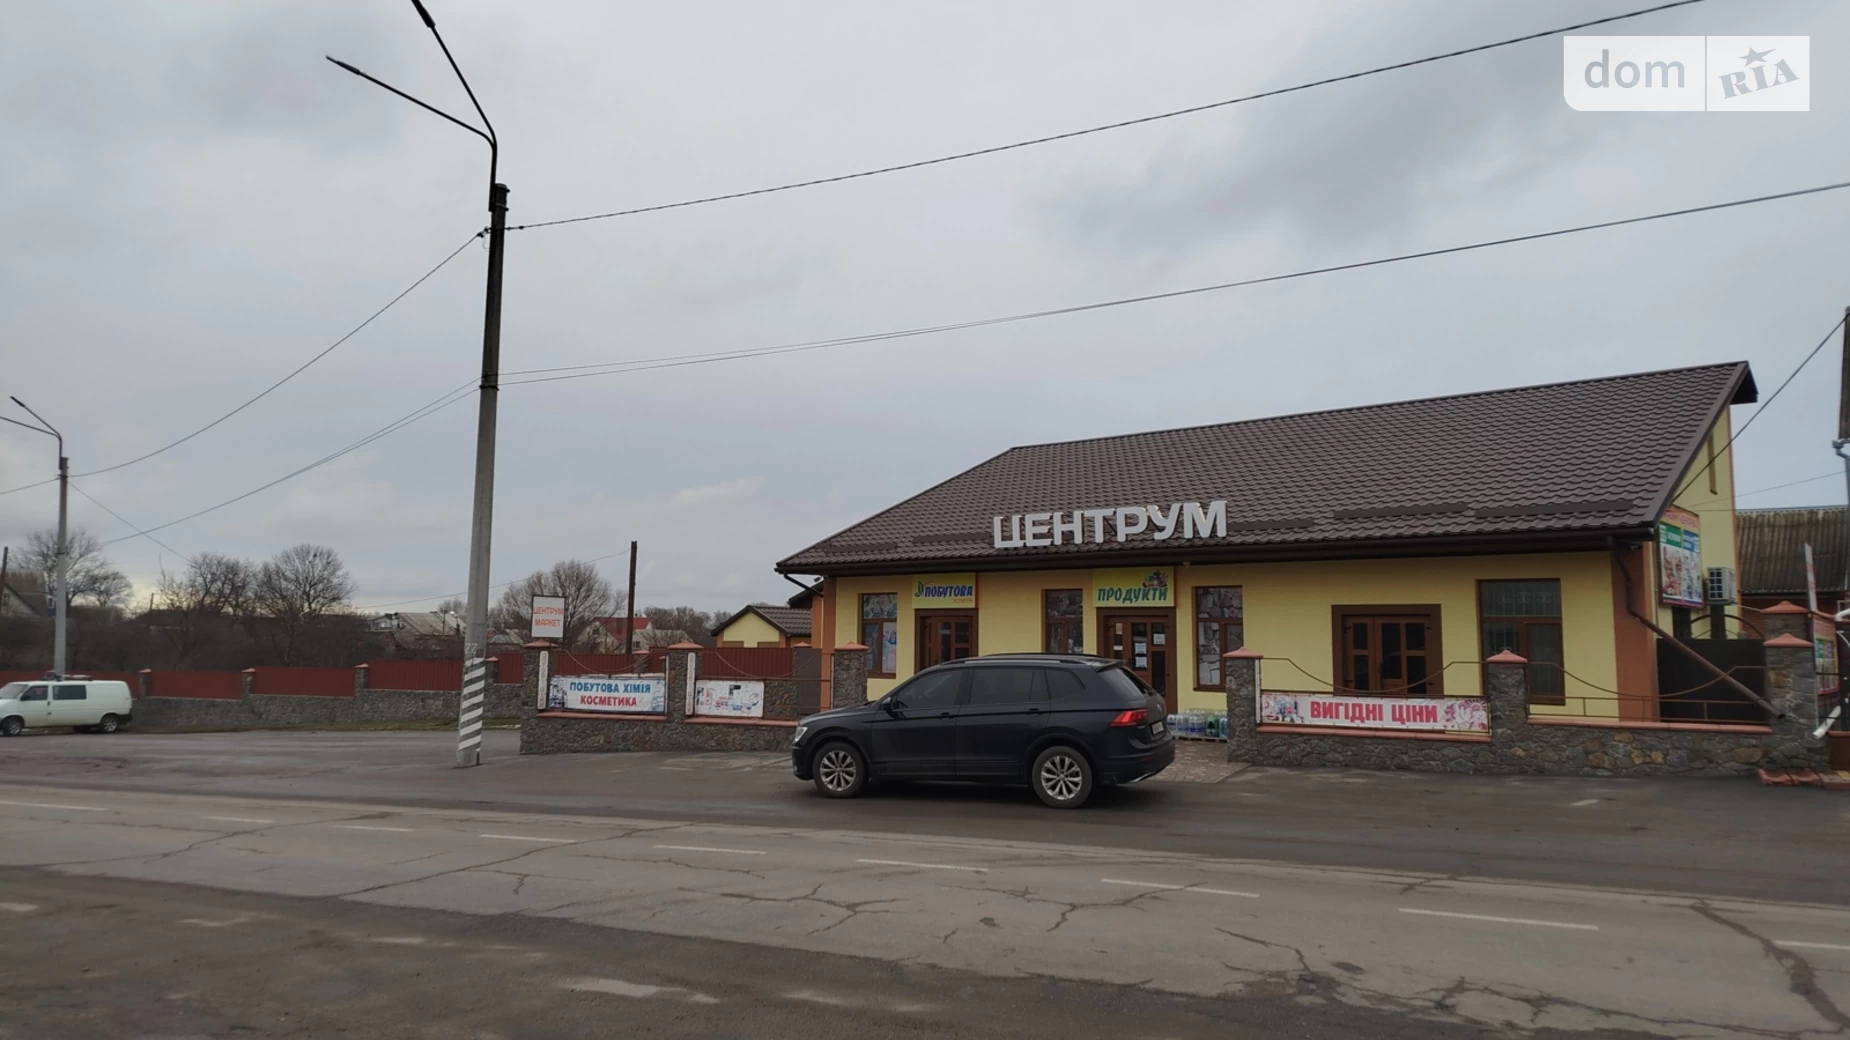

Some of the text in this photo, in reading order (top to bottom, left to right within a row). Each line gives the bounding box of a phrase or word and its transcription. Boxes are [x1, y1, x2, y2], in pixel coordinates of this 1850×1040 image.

[993, 501, 1228, 548] ЦЕНТРУМ
[924, 585, 974, 598] ПОБУТОВА
[1097, 587, 1169, 604] ПРОДУКТИ
[570, 682, 651, 693] ПОБУТОВА ХІМІЯ
[580, 695, 637, 706] КОСМЕТИКА
[1310, 701, 1438, 724] ВИГІДНІ ЦІНИ
